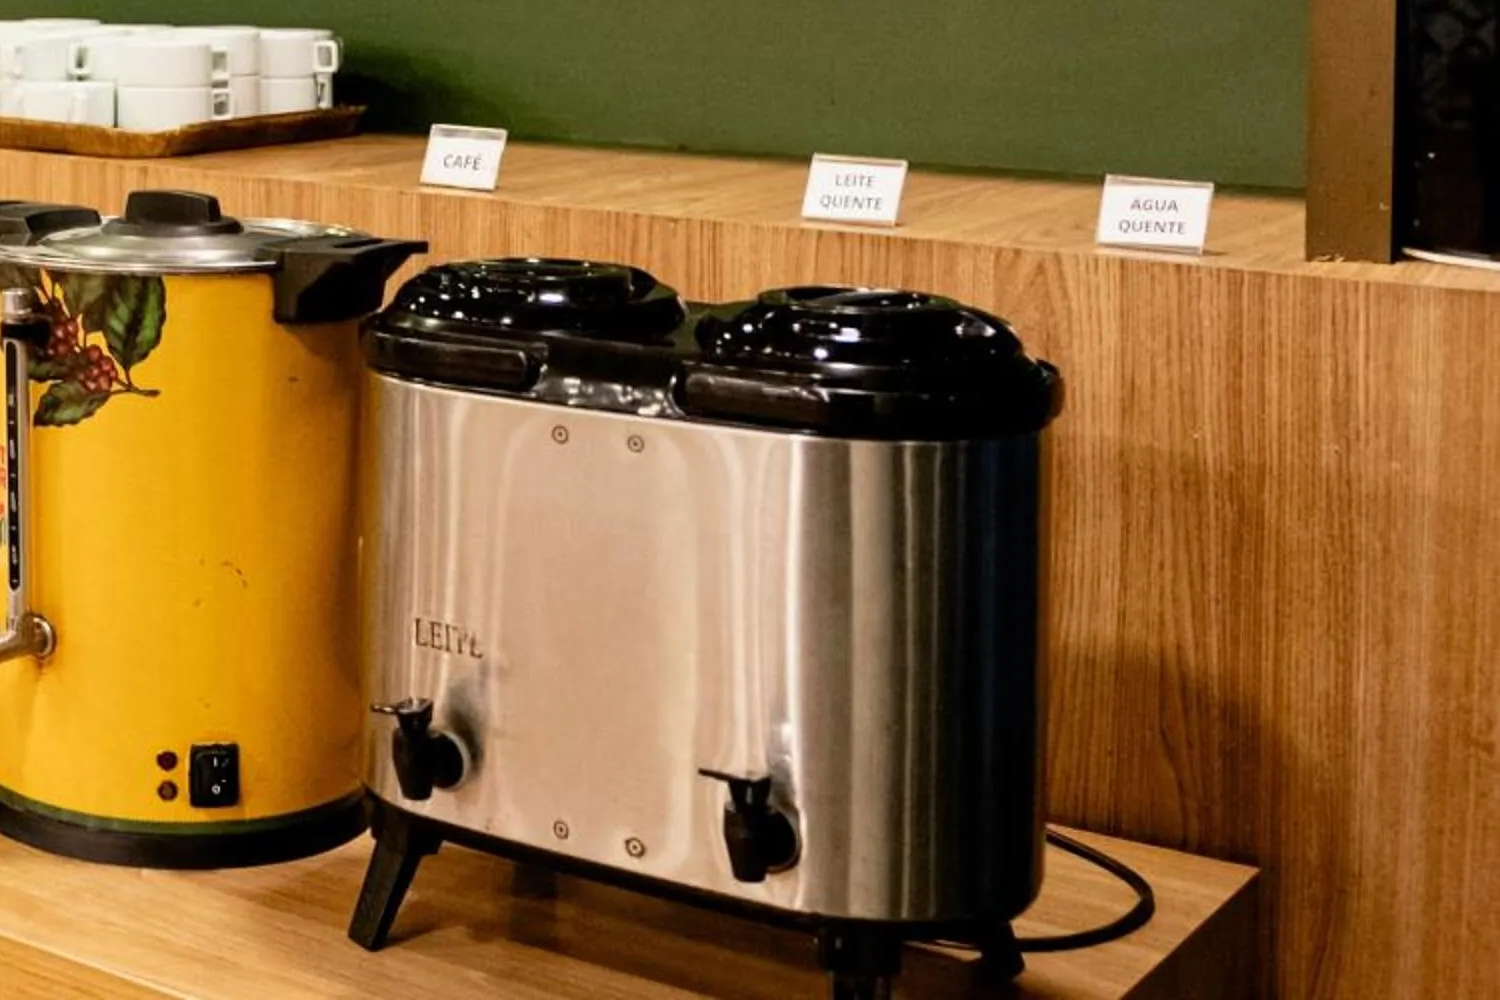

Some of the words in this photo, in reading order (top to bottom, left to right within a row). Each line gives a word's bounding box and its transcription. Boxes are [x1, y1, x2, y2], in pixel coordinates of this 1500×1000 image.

[835, 173, 876, 188] LEITE
[819, 194, 884, 210] QUENTE
[1130, 198, 1179, 213] AGUA
[1118, 219, 1187, 234] QUENTE
